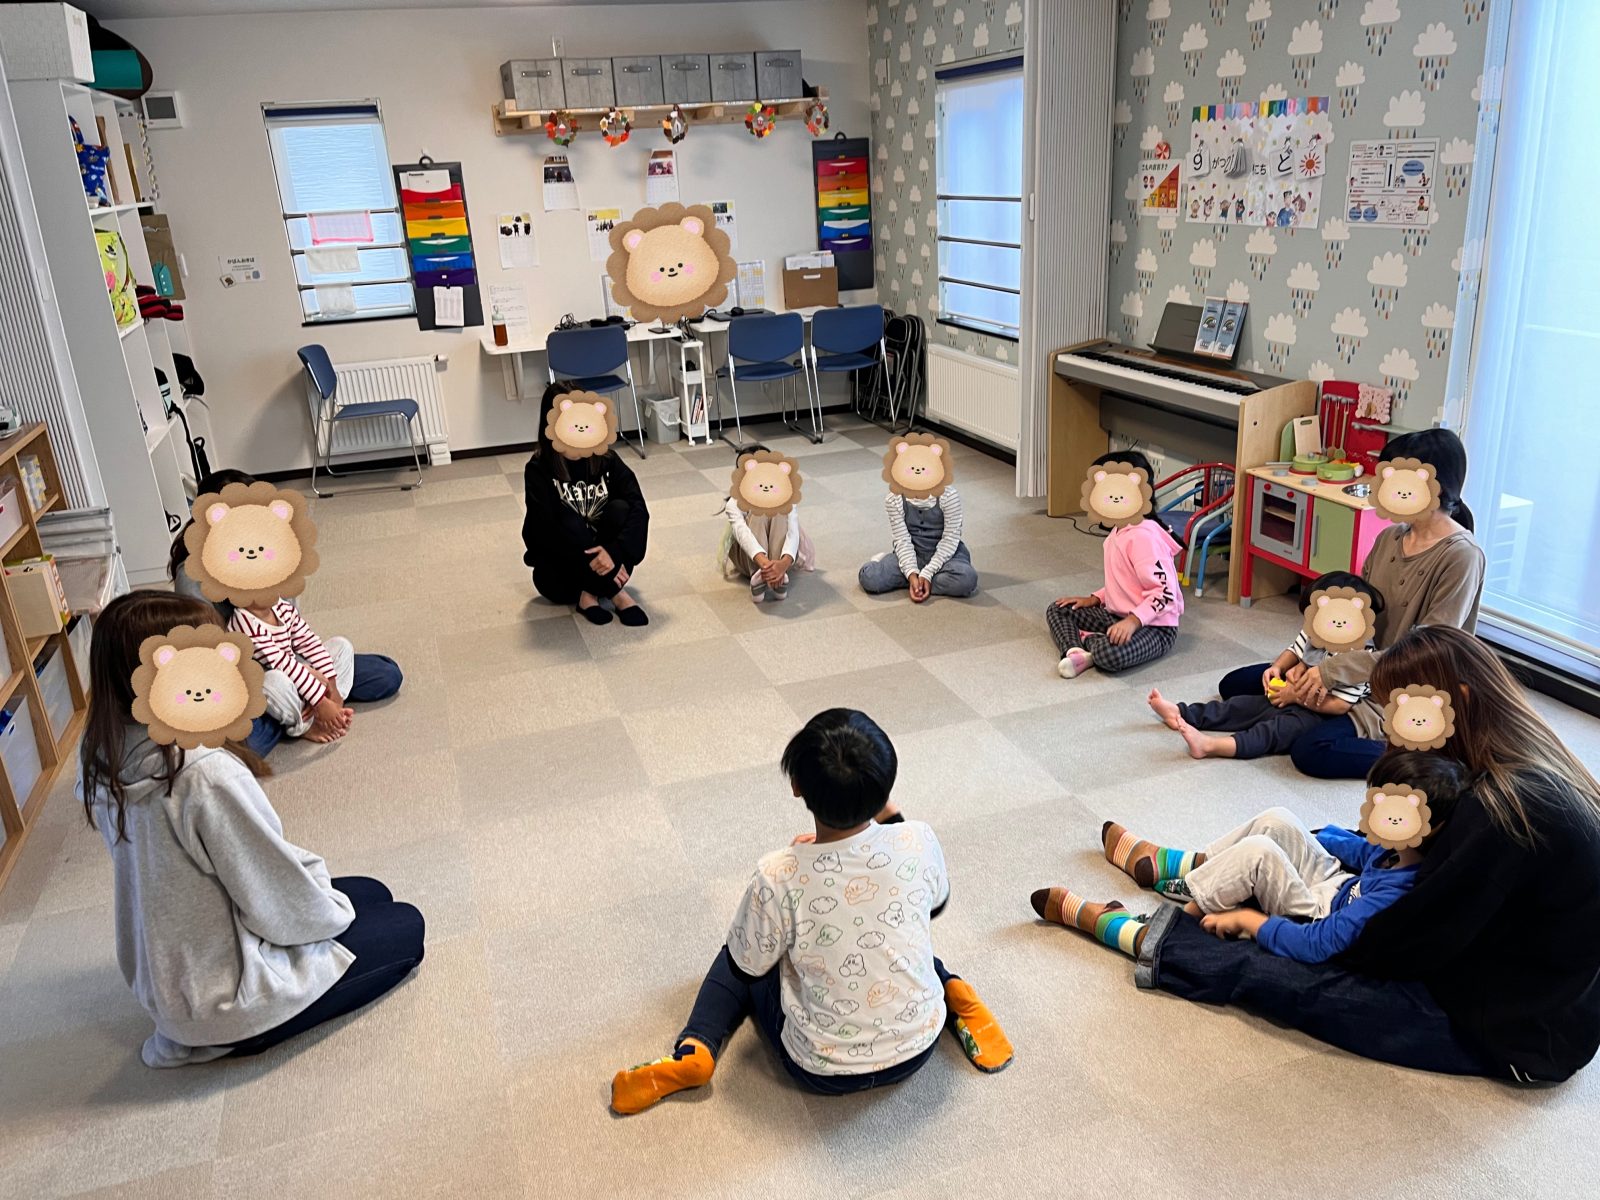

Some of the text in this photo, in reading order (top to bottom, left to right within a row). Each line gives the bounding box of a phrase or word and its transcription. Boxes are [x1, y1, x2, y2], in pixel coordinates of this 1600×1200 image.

[1193, 153, 1203, 171] 9
[1211, 156, 1226, 170] がつ
[1252, 163, 1267, 176] にち
[1277, 148, 1293, 173] ど
